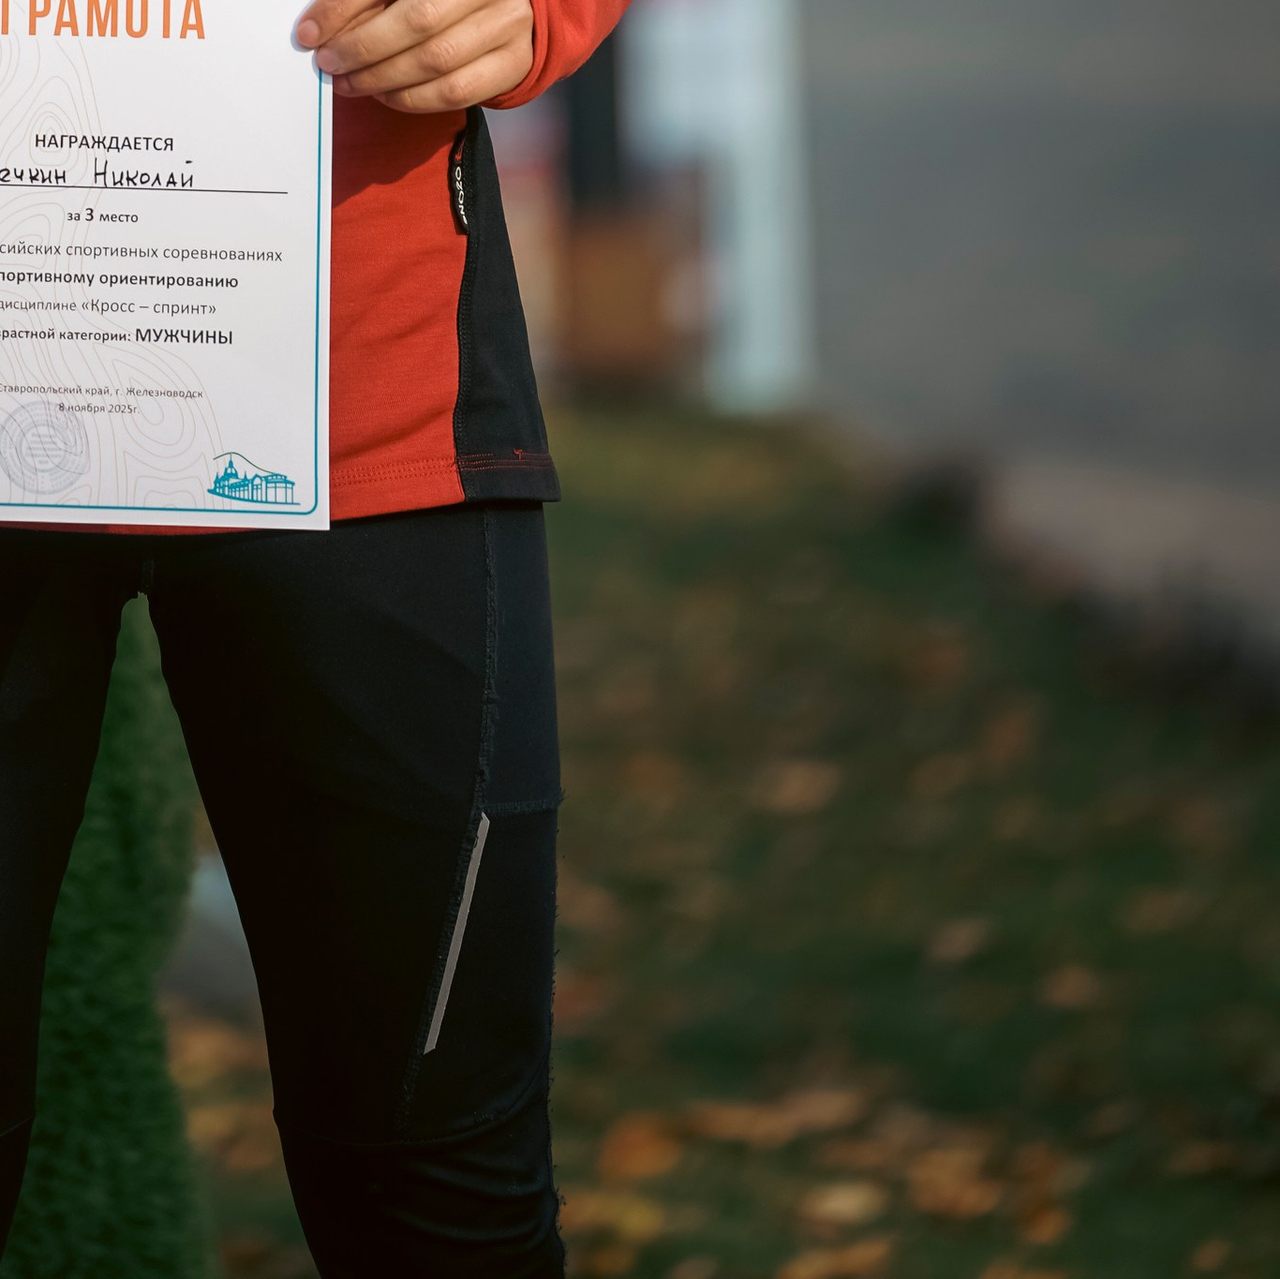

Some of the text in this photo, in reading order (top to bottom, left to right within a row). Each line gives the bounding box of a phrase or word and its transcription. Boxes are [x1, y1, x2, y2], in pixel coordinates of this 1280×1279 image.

[35, 133, 174, 152] НАГРАЖДАЕТСЯ
[67, 208, 139, 223] за 3 место
[65, 245, 159, 260] спортивных
[163, 248, 283, 262] соревнованиях
[99, 274, 239, 289] ориентированию
[81, 299, 136, 315] «Кросс
[153, 303, 217, 317] спринт»
[59, 331, 131, 344] категории:
[135, 328, 233, 345] МУЖЧИНЫ
[125, 387, 203, 400] Железноводск
[58, 402, 65, 413] 8
[67, 403, 106, 414] ноября
